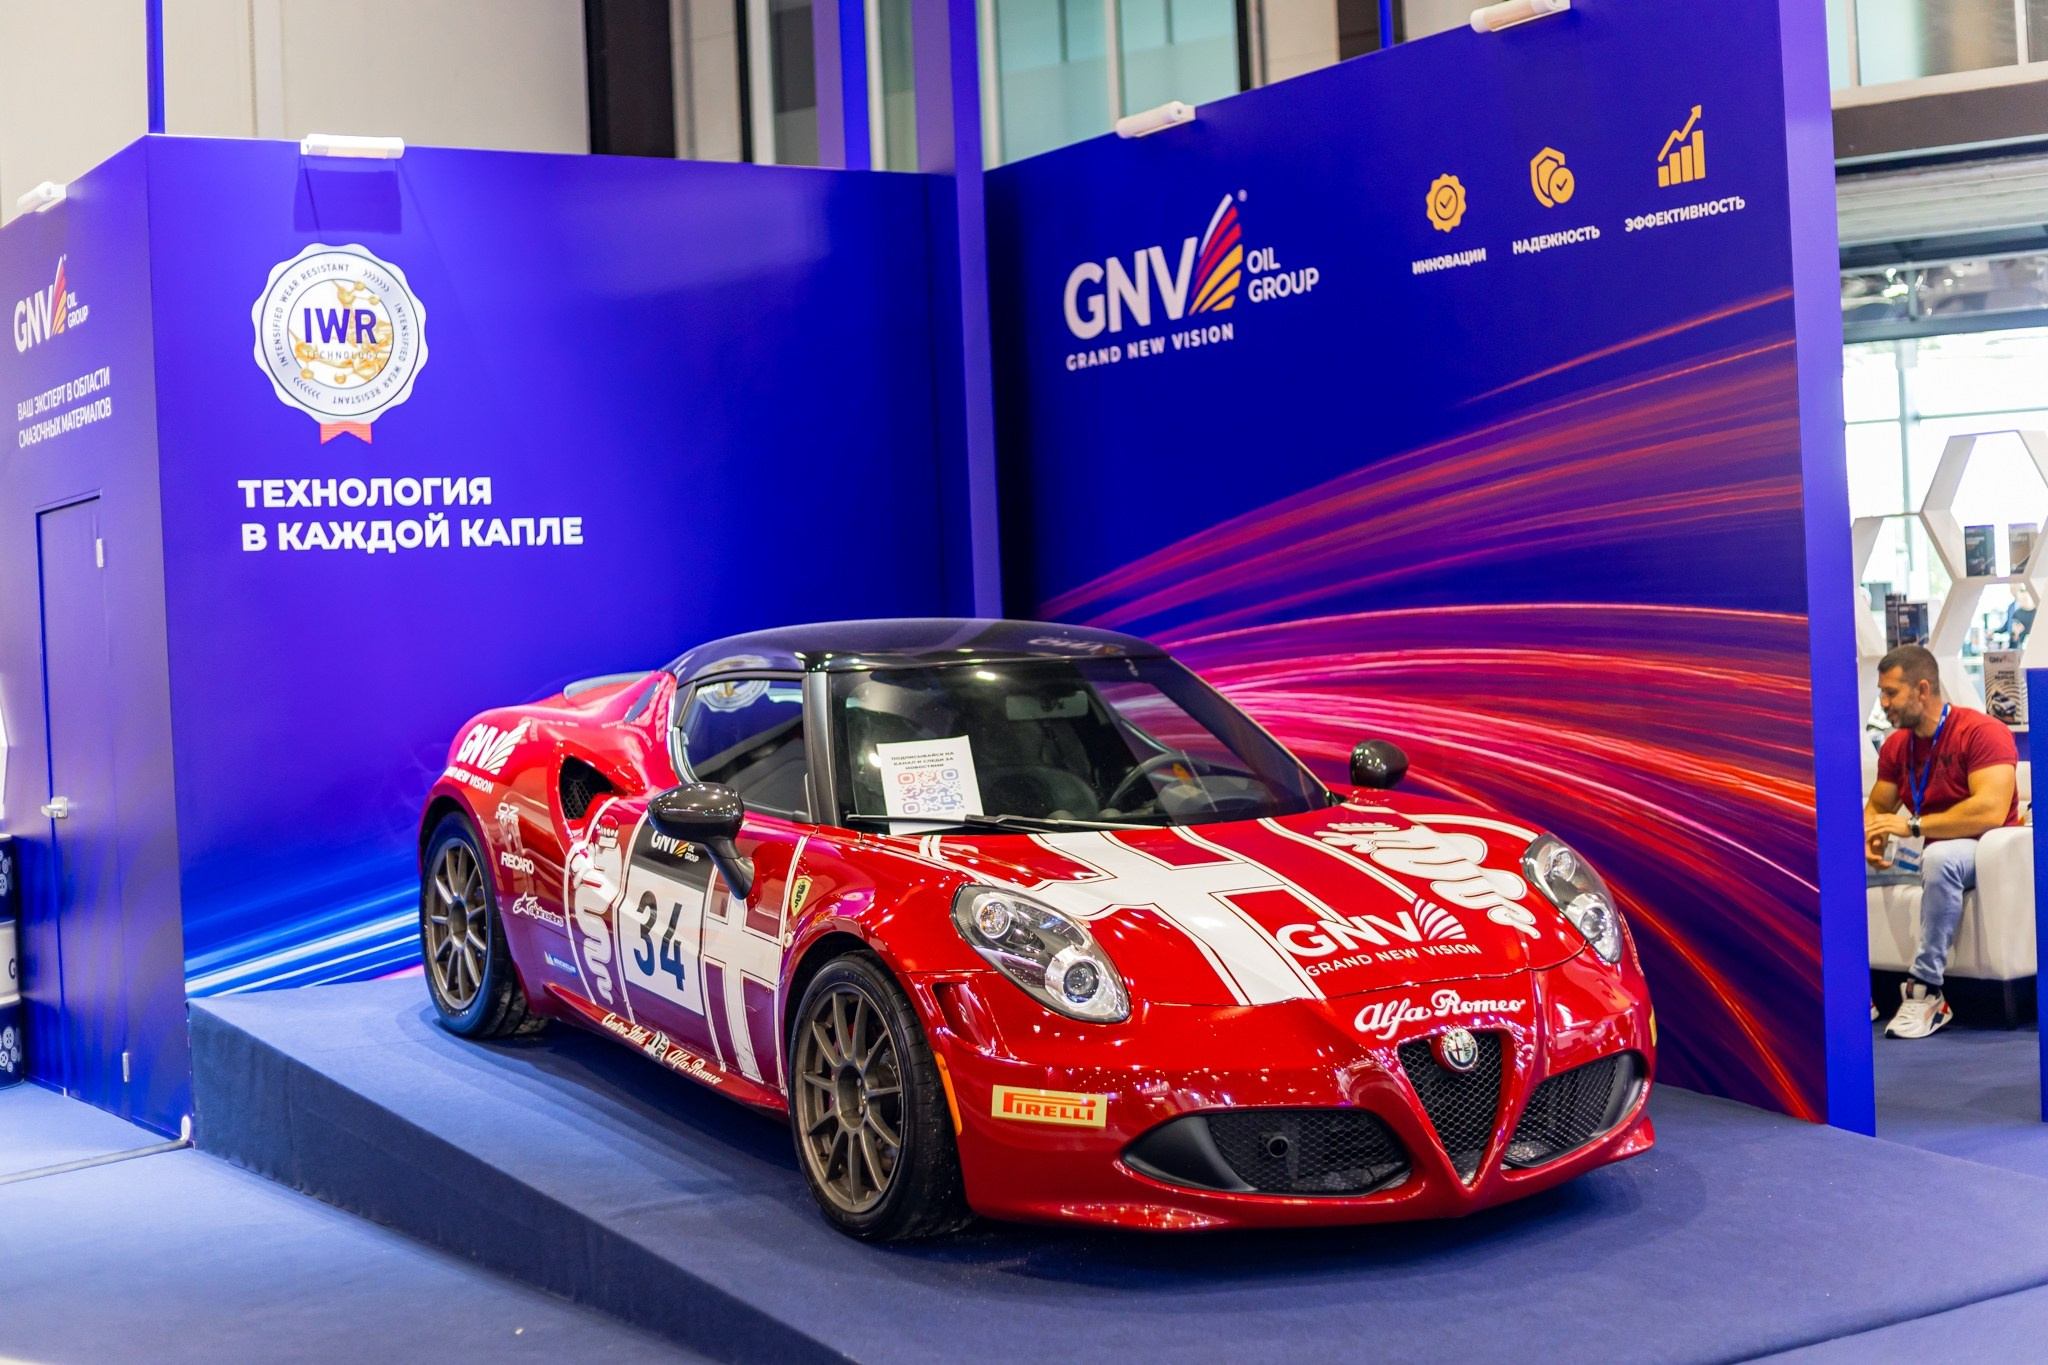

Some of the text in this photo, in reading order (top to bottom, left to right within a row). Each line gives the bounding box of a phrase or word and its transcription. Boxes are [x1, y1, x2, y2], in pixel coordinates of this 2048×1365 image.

[1624, 195, 1746, 233] ЭФФЕКТИВНОСТЬ
[1512, 225, 1601, 255] НАДЕЖНОСТЬ
[1246, 247, 1281, 274] OIL
[1411, 248, 1487, 275] ИННОВАЦИИ
[66, 291, 78, 309] OIL
[1063, 236, 1198, 340] GNV
[1248, 267, 1320, 303] GROUP
[14, 284, 54, 353] GNV
[67, 304, 89, 329] GROUP
[272, 263, 350, 367] INTENSIFIED WEAR RESISTANT
[304, 307, 378, 344] IWR
[394, 303, 409, 362] INTENSIFIED
[306, 350, 379, 360] TECHNOLOGY
[1066, 323, 1234, 371] GRAND NEW VISION
[17, 366, 110, 421] ВАШ ЭКСПЕРТ В ОБЛАСТИ
[332, 388, 382, 405] RESISTANT
[18, 396, 112, 448] СМАЗОЧНЫХ МАТЕРИАЛОВ
[238, 476, 492, 508] ТЕХНОЛОГИЯ
[241, 512, 584, 554] В КАЖДОЙ КАПЛЕ
[456, 722, 508, 769] GNV
[469, 773, 494, 794] VISION
[651, 830, 680, 855] GNV
[501, 851, 534, 875] RECARO
[633, 890, 686, 992] 34
[1275, 911, 1423, 957] GNV
[1305, 943, 1482, 977] GRAND NEW VISION
[1354, 998, 1432, 1040] Alfa
[1431, 989, 1526, 1016] Romeo
[666, 1049, 723, 1085] Alfa Romeo
[1003, 1091, 1097, 1121] PIRELLI
